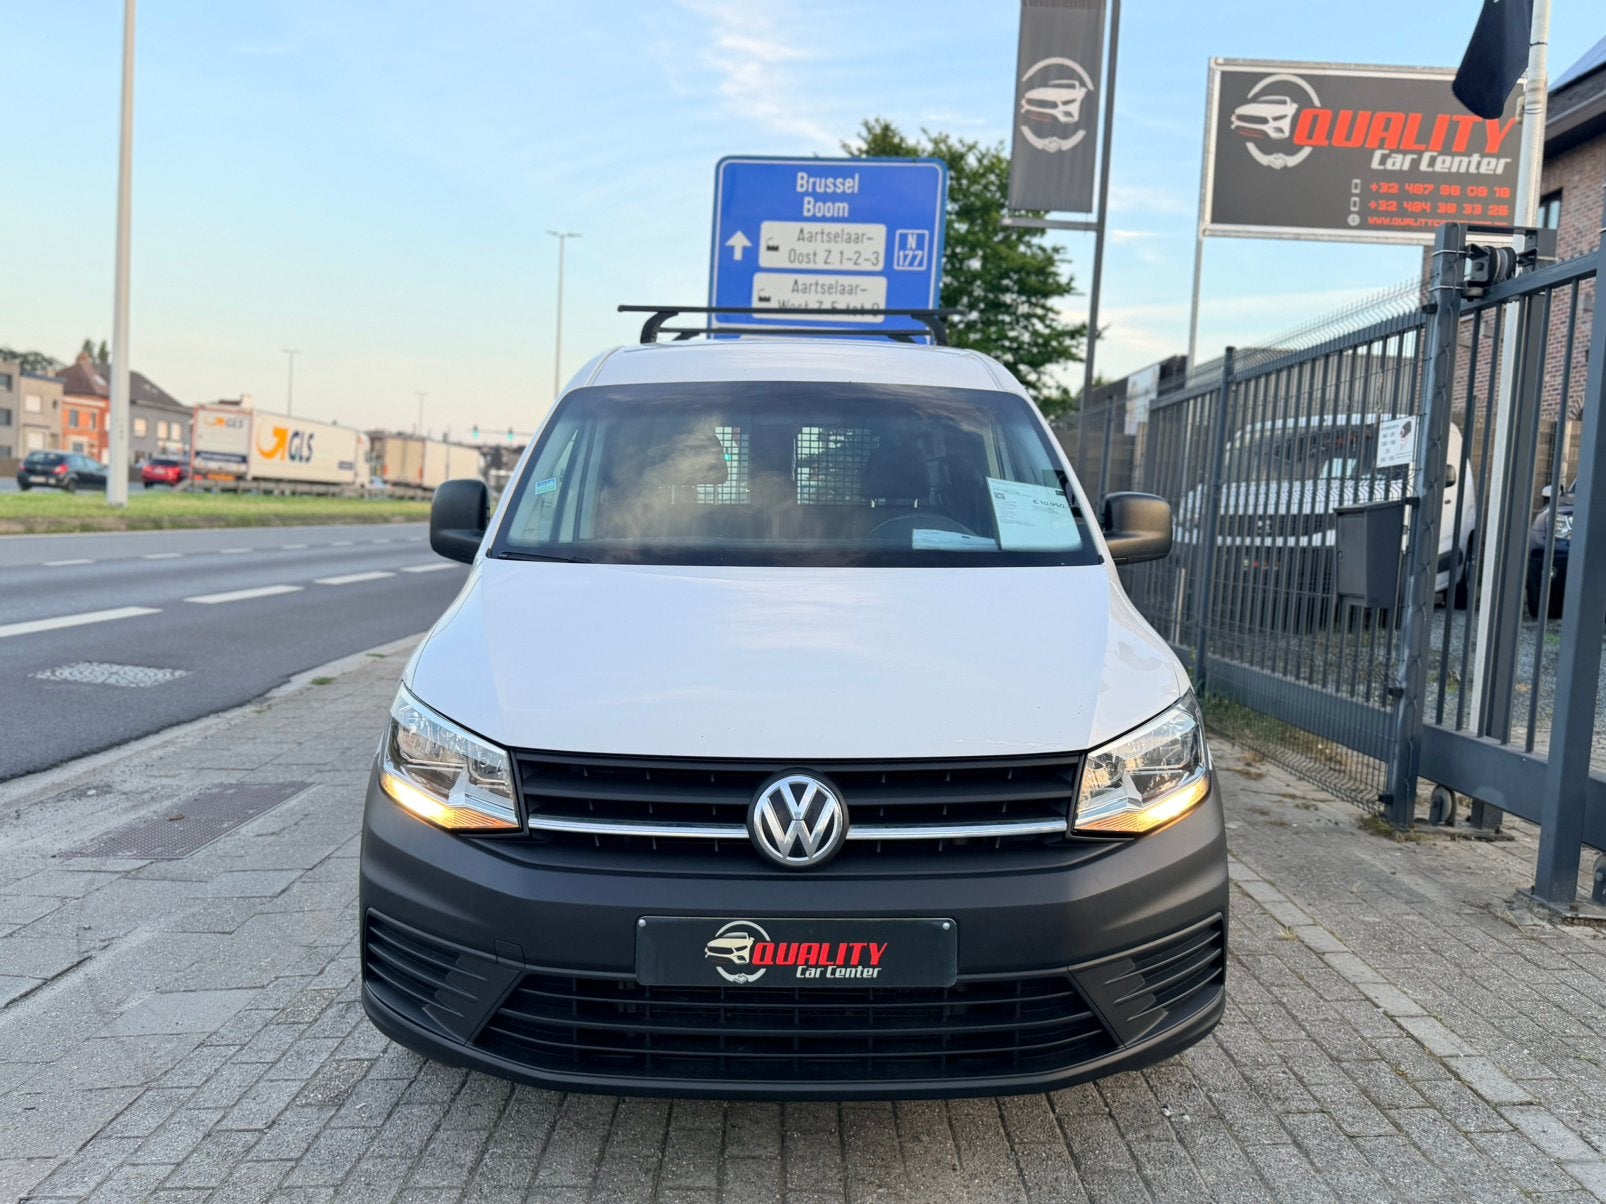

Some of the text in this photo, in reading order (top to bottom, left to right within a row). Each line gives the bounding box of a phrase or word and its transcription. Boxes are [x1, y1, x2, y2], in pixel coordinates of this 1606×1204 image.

[1293, 108, 1517, 153] QUALITY
[1370, 149, 1511, 175] Car Center
[796, 171, 859, 194] Brussel
[1369, 181, 1399, 194] +32
[803, 196, 849, 218] Boom
[1368, 199, 1398, 212] +32
[796, 227, 874, 244] Aartselaar-
[907, 233, 916, 249] N
[788, 248, 818, 265] Oost
[898, 251, 923, 268] 177
[791, 278, 868, 296] Aartselaar-
[288, 430, 315, 463] GLS
[752, 942, 888, 966] QUALITY
[795, 965, 882, 980] Car Center
